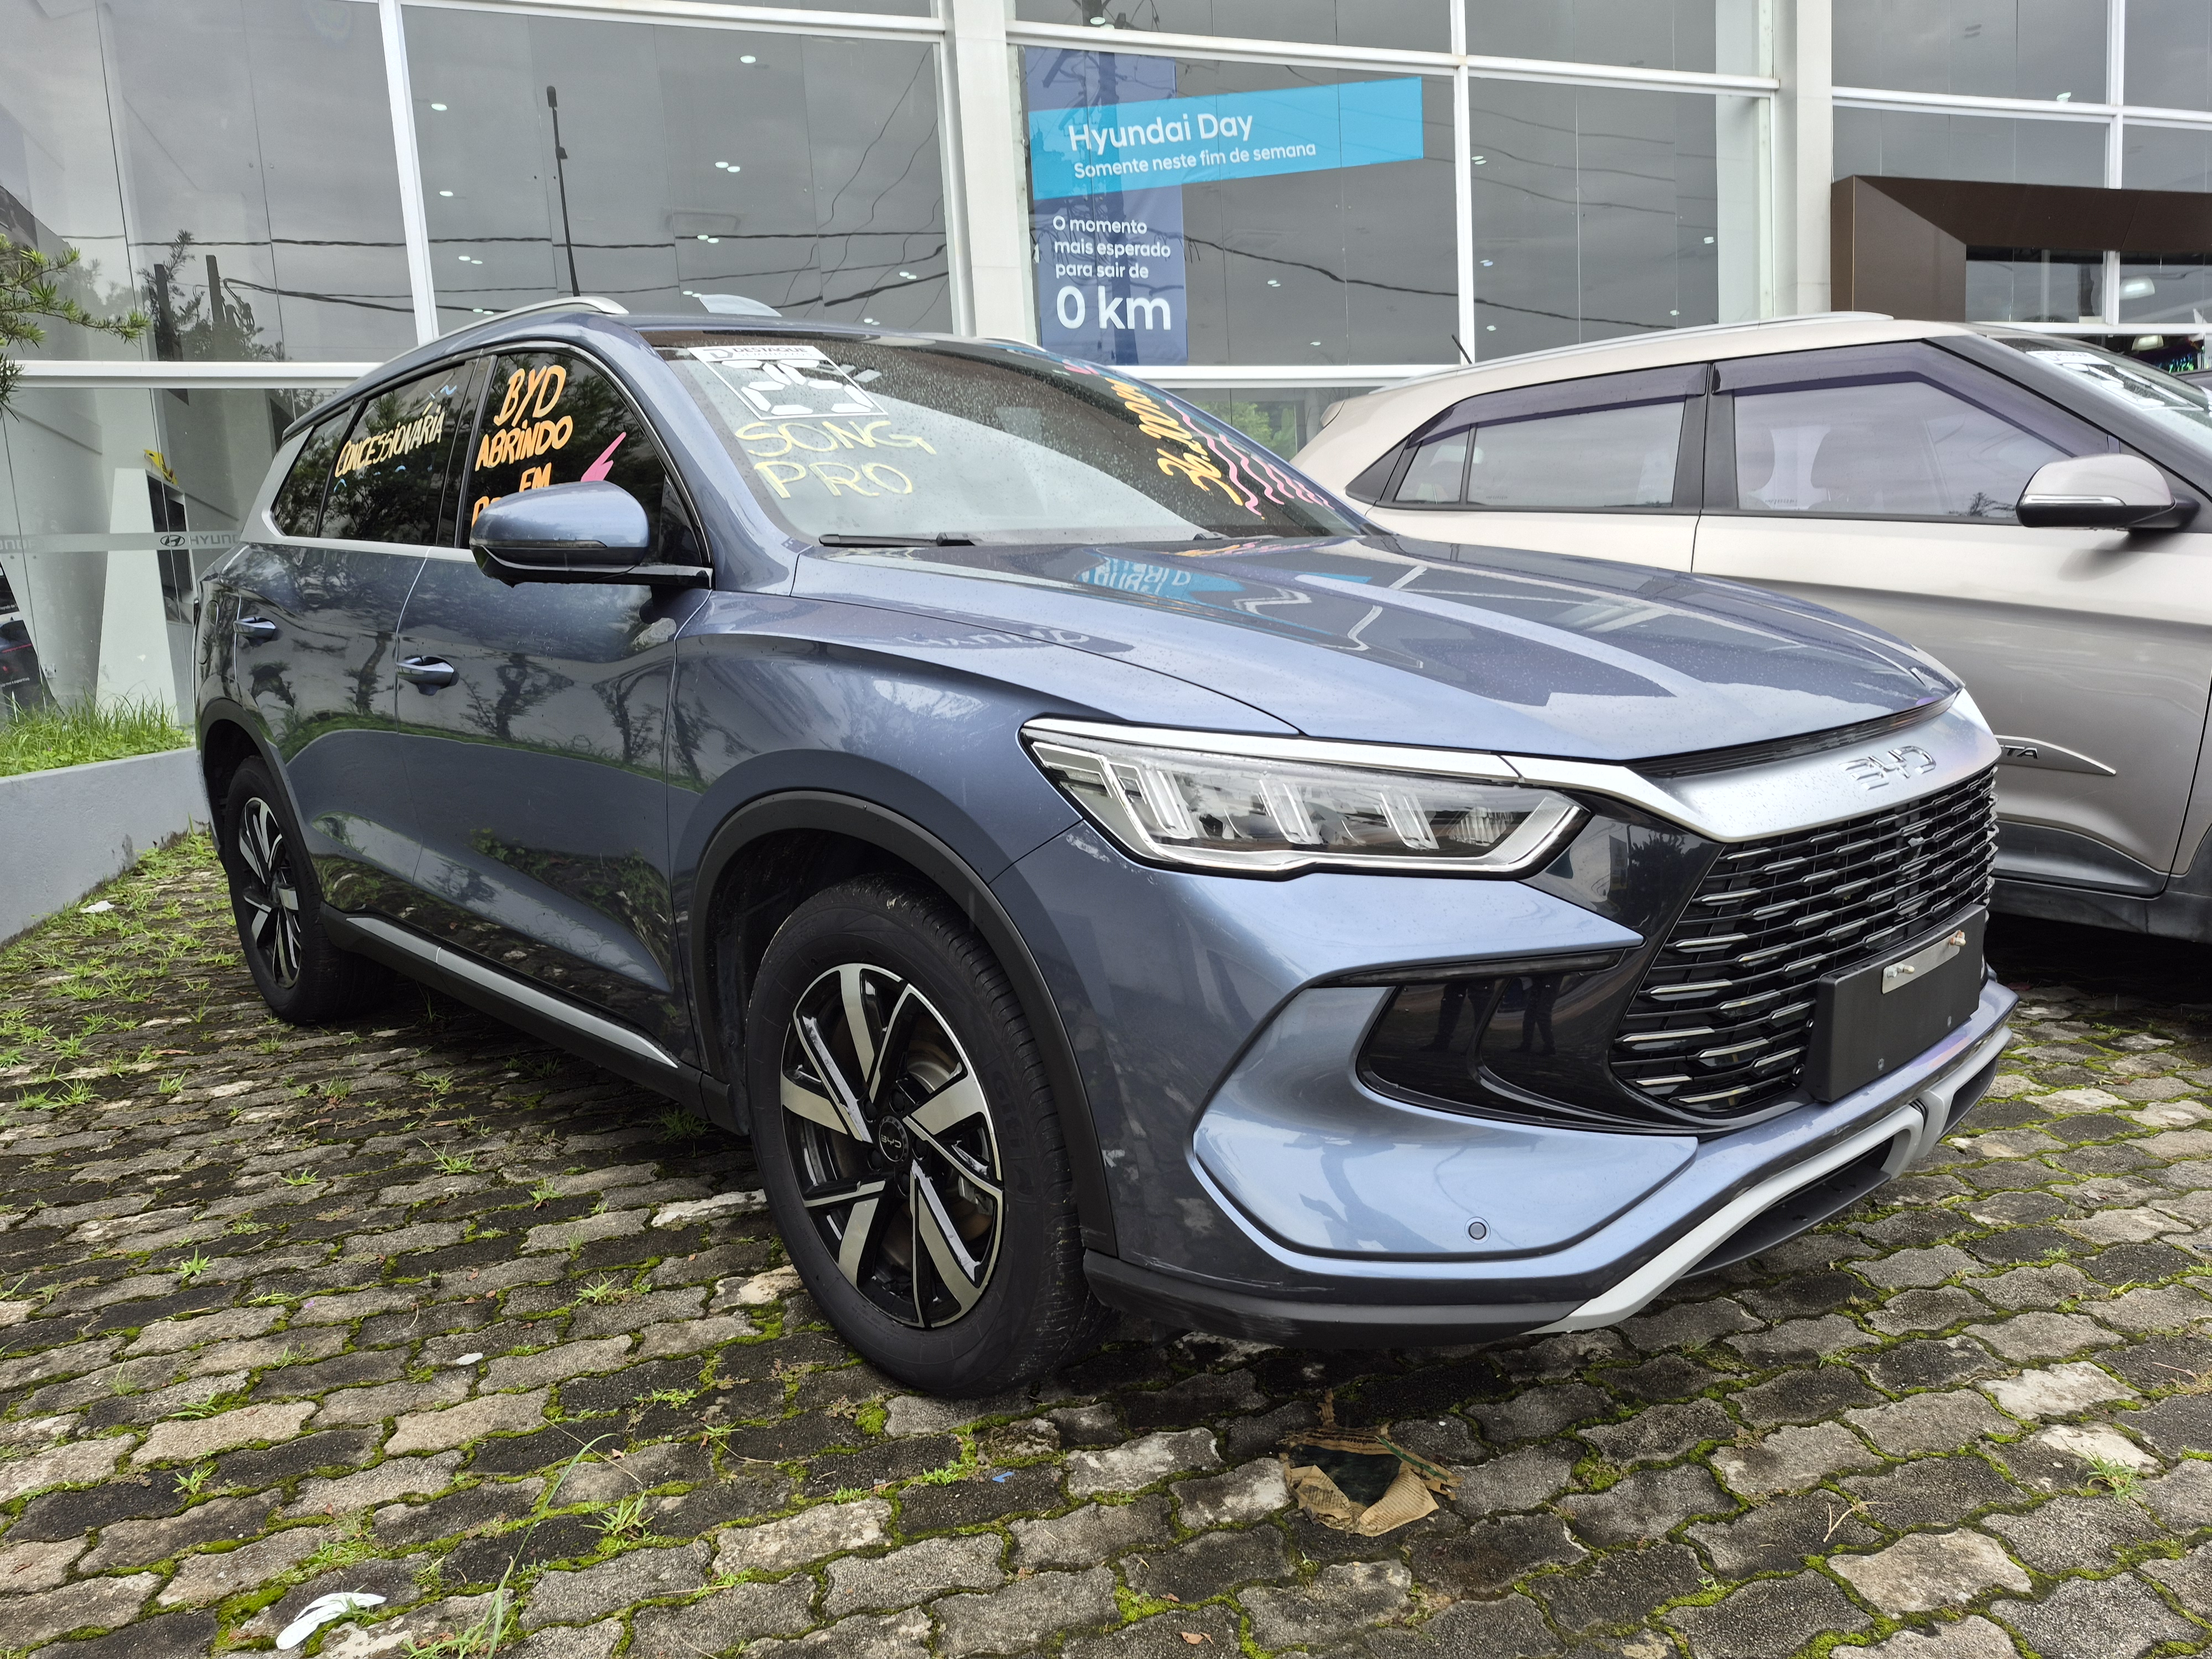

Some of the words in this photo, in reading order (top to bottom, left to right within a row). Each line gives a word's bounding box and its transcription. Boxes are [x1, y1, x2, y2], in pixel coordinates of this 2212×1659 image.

[1068, 113, 1191, 155] Hyundai
[1197, 113, 1253, 142] Day
[1074, 158, 1149, 179] Somente
[1153, 154, 1197, 171] neste
[1200, 150, 1226, 166] fim
[1230, 148, 1250, 164] de
[1254, 143, 1316, 161] semana
[1053, 215, 1066, 231] O
[1070, 219, 1147, 234] momento
[1054, 238, 1094, 255] mais
[1097, 241, 1171, 258] esperado
[1056, 263, 1093, 279] para
[1097, 262, 1125, 278] sair
[1129, 263, 1149, 279] de
[1057, 285, 1086, 329] 0
[1098, 285, 1171, 330] km
[494, 364, 567, 428] BYD
[474, 415, 573, 472] ABRINDO
[735, 420, 937, 457] SONG
[519, 462, 552, 493] EM
[754, 461, 914, 498] PRO
[1839, 745, 1937, 791] BYD
[880, 1134, 902, 1149] BYD
